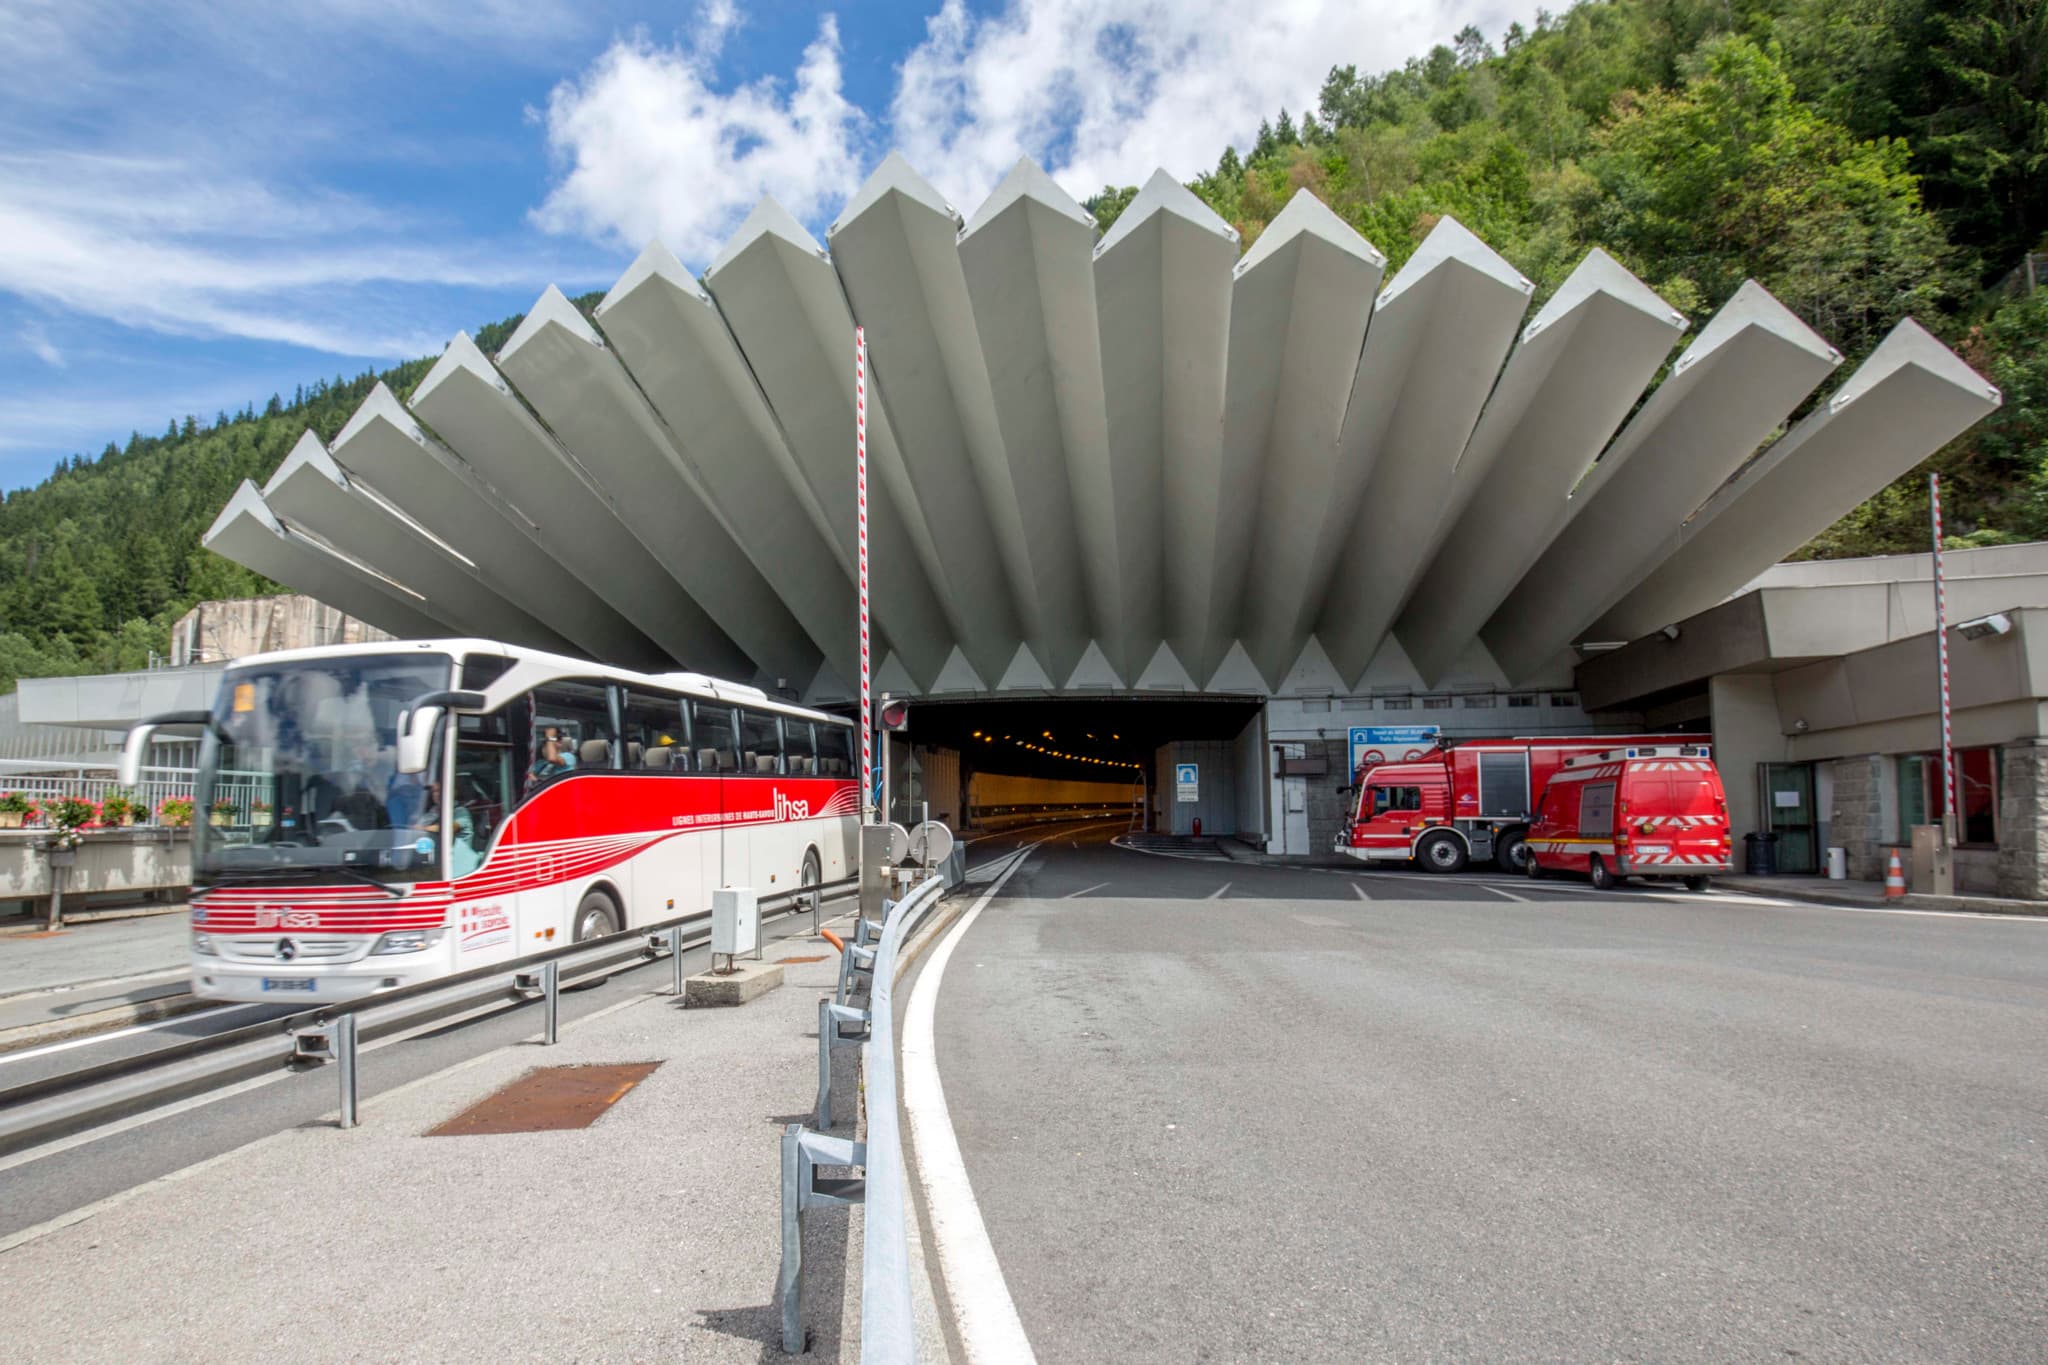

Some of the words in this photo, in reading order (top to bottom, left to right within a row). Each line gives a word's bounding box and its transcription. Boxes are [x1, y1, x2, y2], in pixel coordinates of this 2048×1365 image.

[672, 815, 694, 826] LIGNES
[735, 811, 743, 821] DE
[773, 787, 809, 821] lihsa
